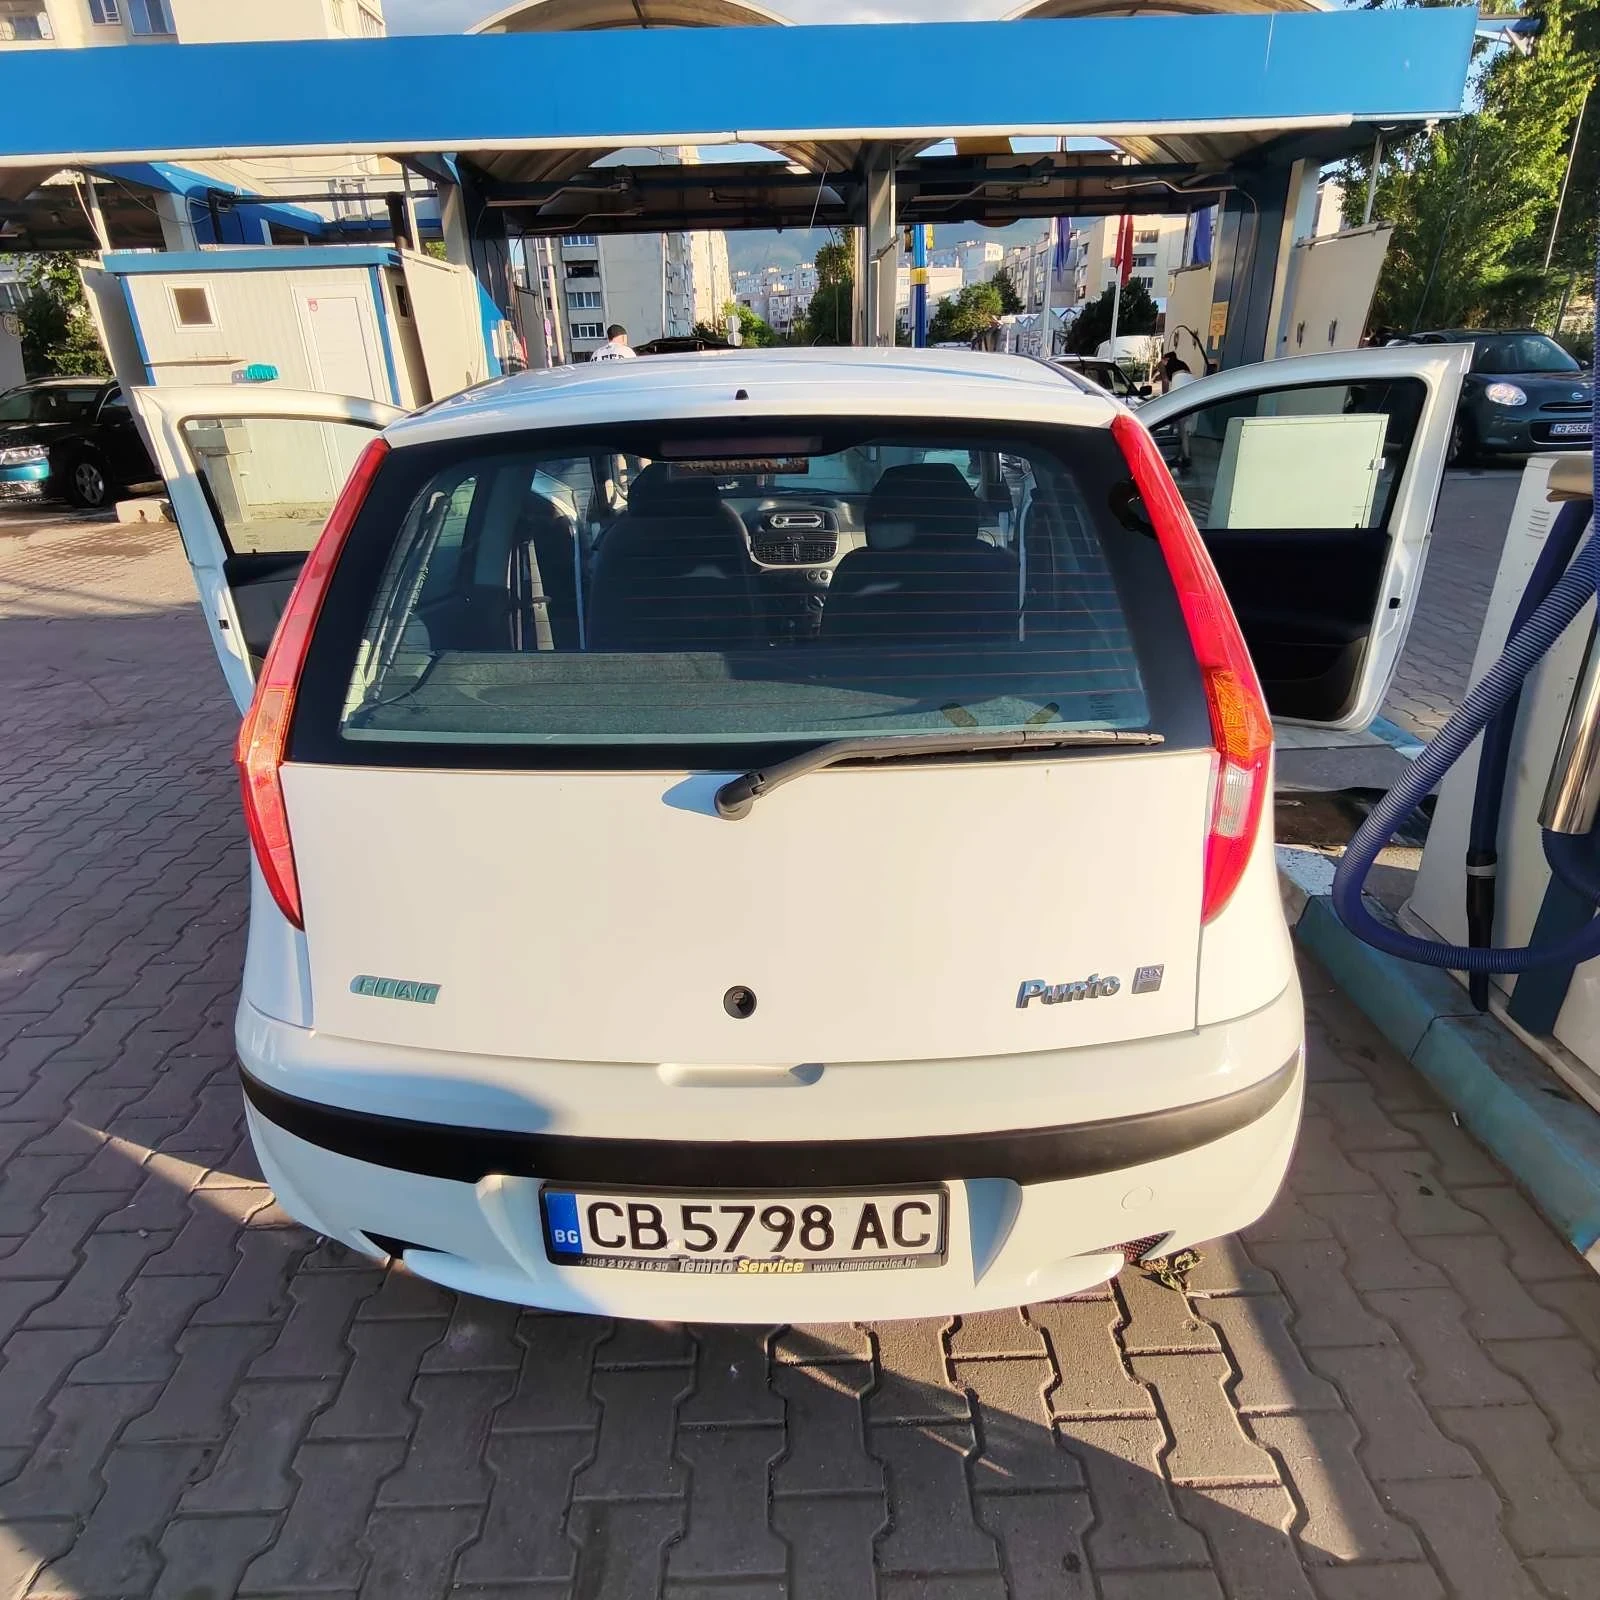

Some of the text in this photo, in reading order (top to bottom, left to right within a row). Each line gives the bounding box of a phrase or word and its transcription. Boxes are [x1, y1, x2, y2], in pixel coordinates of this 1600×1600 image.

[356, 977, 438, 1002] FIAT
[1016, 973, 1121, 1008] Punto
[554, 1229, 579, 1244] BG
[587, 1201, 932, 1252] CB 5798 AC
[678, 1258, 805, 1273] Tempo Service
